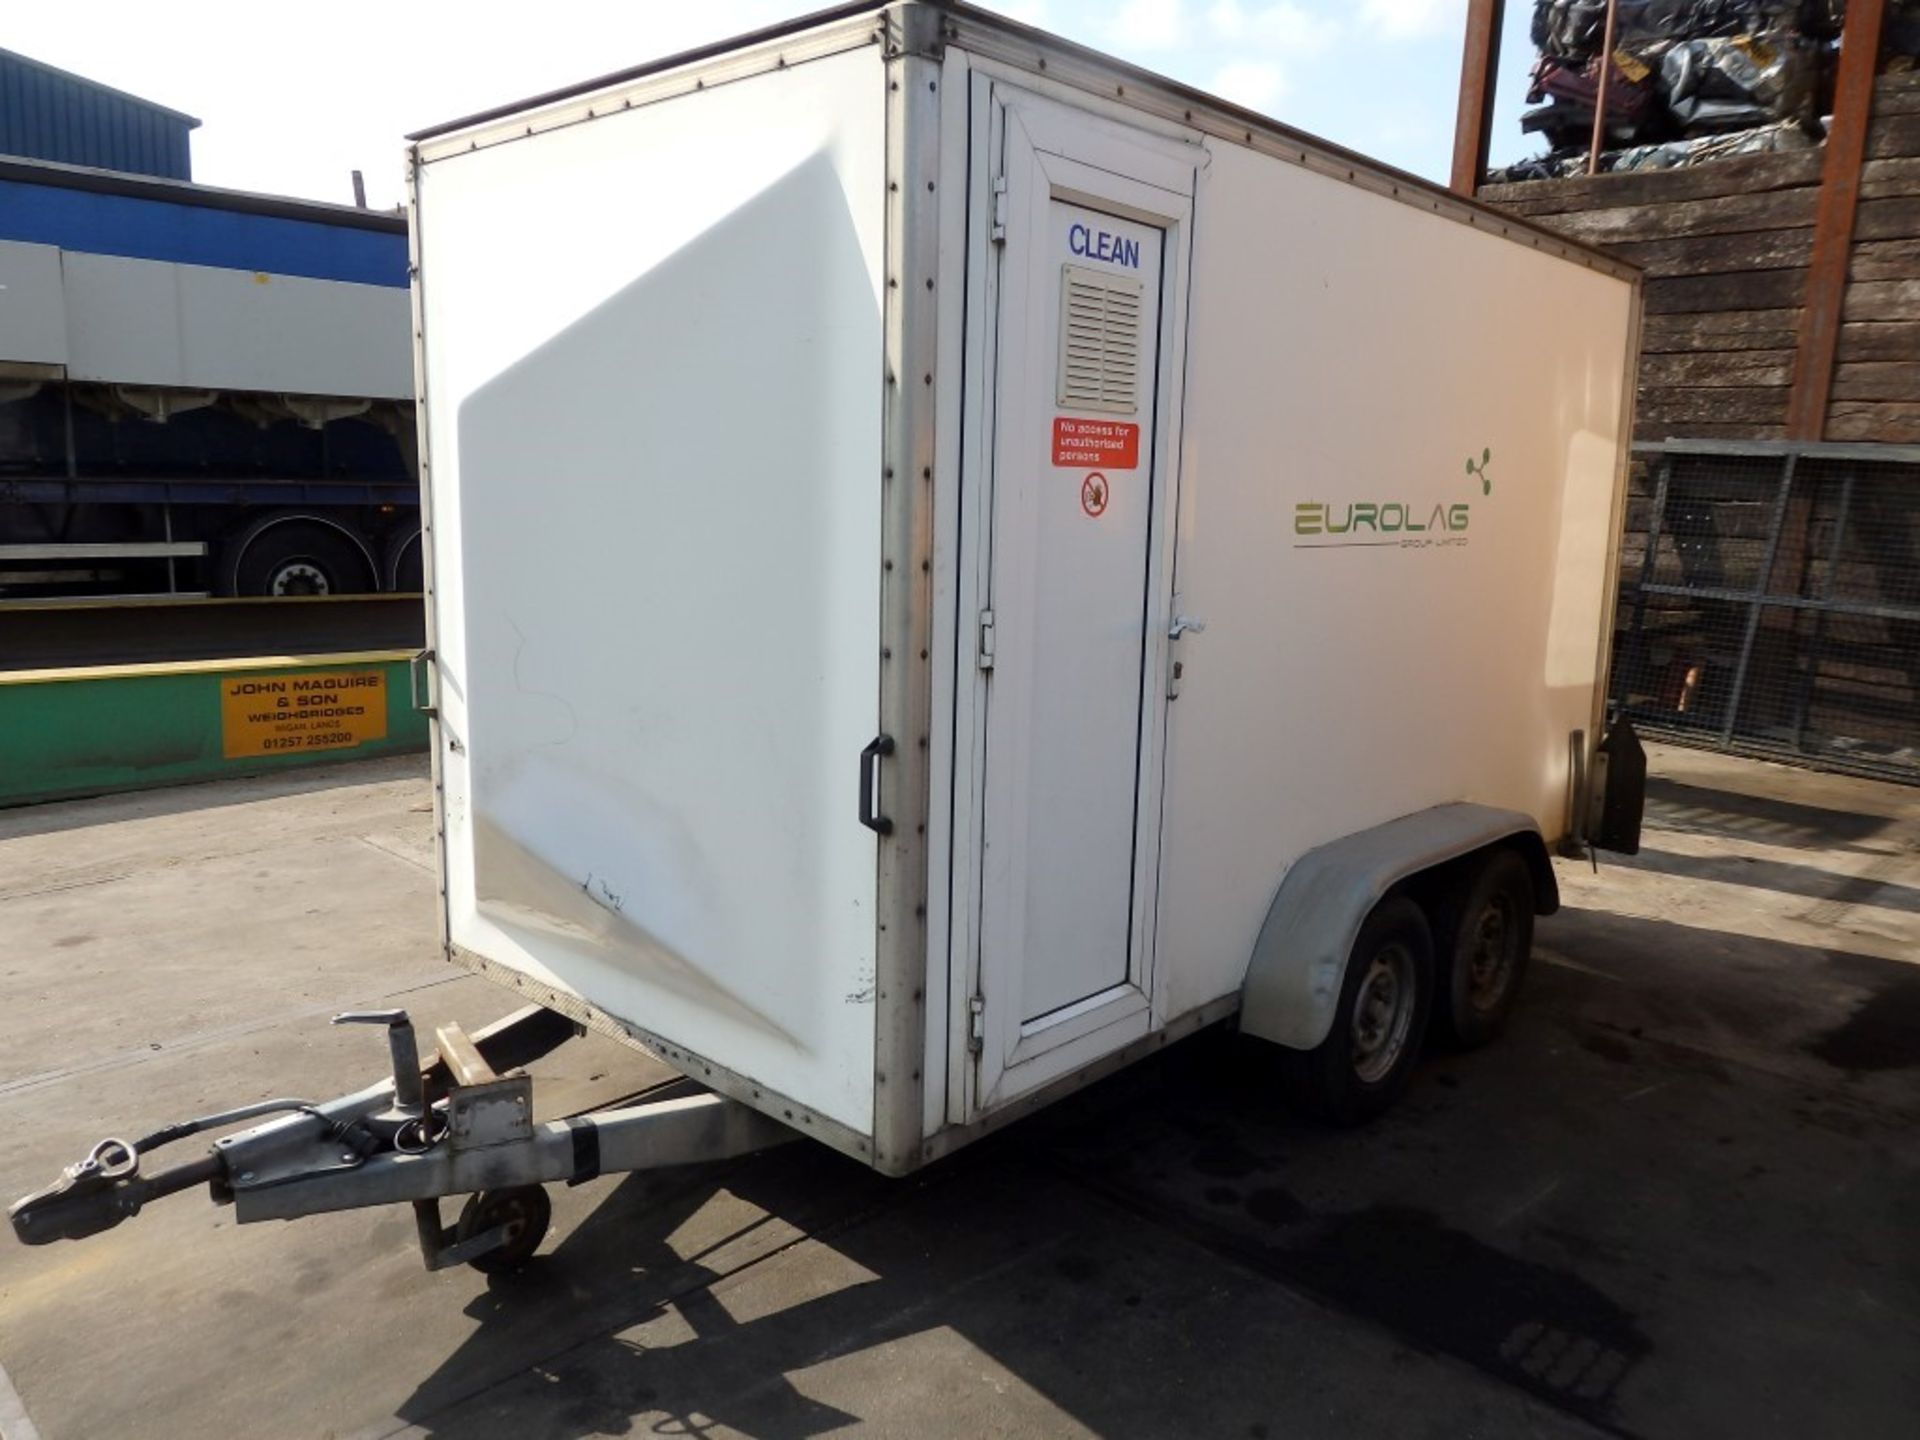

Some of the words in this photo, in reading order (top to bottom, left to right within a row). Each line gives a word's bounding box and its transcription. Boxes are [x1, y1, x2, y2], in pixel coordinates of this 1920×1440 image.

[1069, 224, 1139, 269] CLEAN
[1060, 421, 1075, 432] No
[1077, 425, 1113, 436] access
[1115, 426, 1129, 436] for
[1059, 451, 1100, 463] persons
[1295, 503, 1469, 534] EUROLAG
[230, 683, 285, 696] JOHN
[293, 677, 379, 690] MAGUIRE
[277, 697, 289, 708] &
[297, 695, 338, 706] SON
[248, 707, 365, 722] WEIGHBRIDGES
[264, 737, 302, 749] 01257
